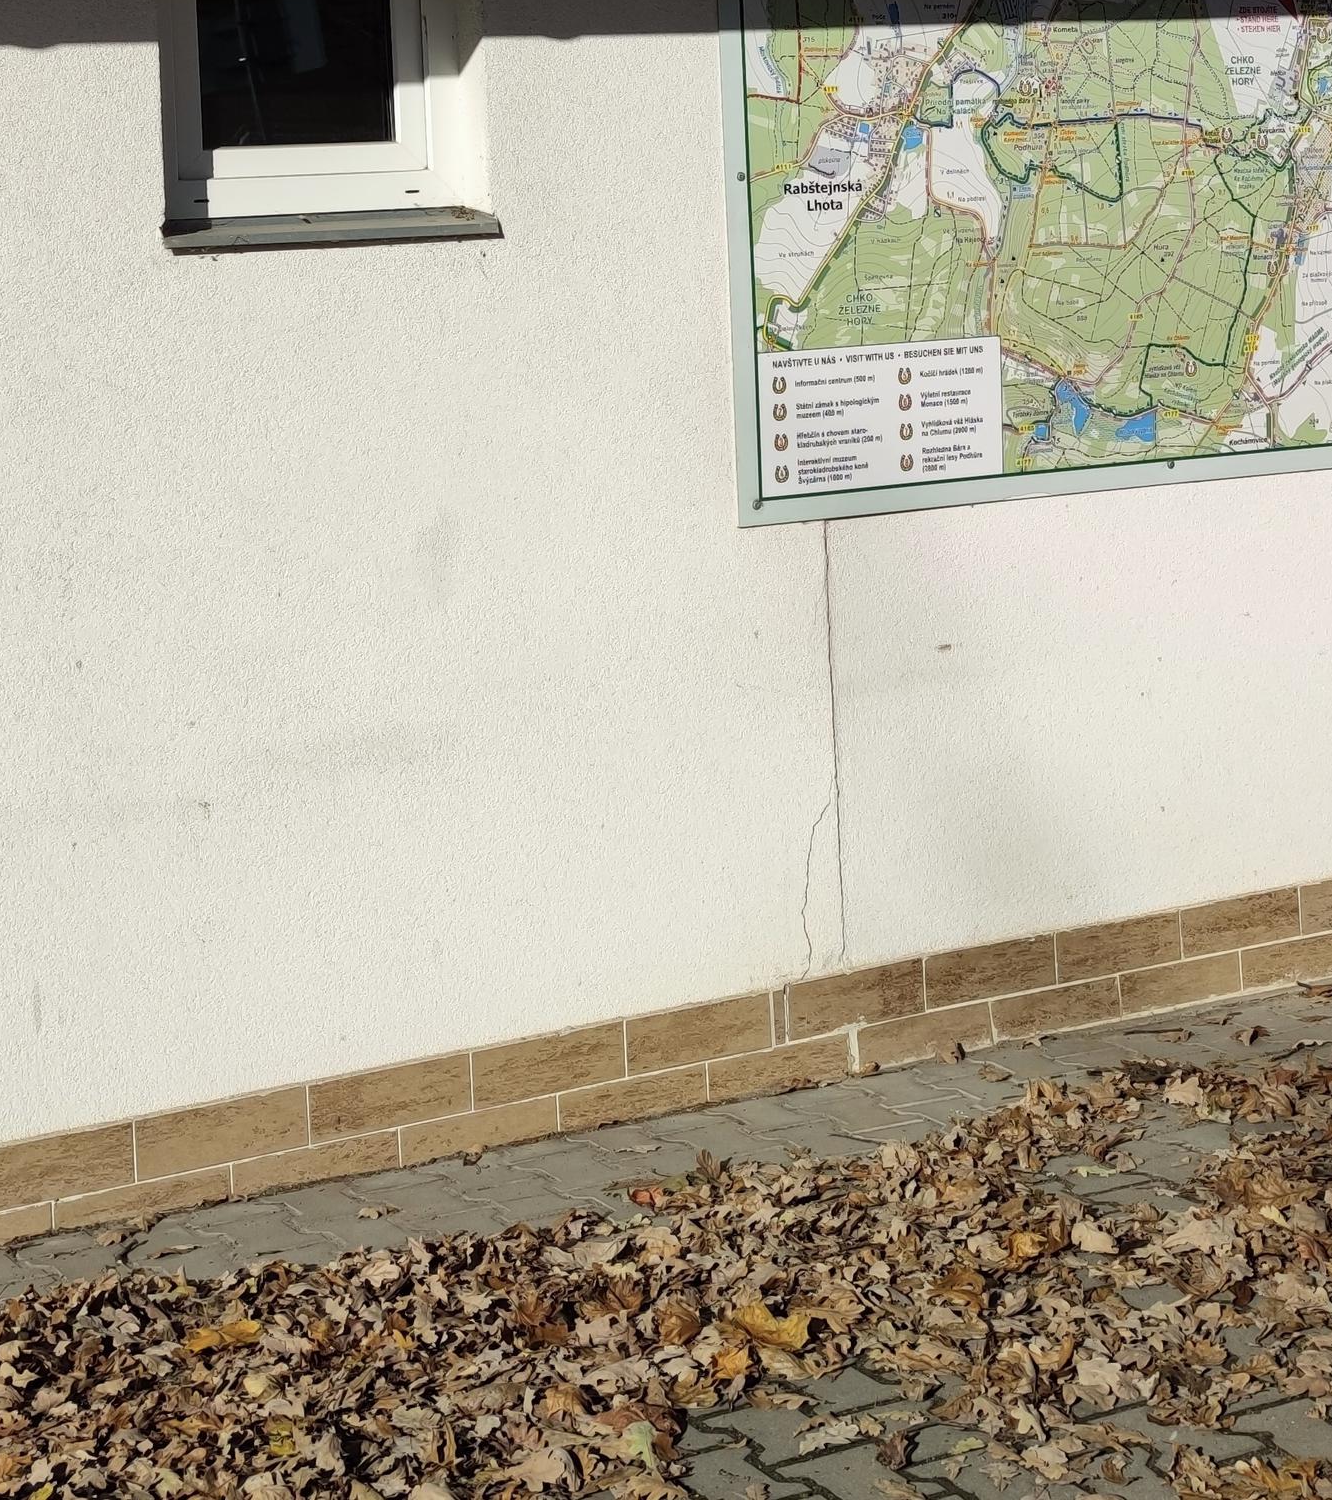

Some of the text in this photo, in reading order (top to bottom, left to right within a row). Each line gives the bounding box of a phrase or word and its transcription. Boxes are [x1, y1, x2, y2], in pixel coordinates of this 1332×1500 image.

[1231, 56, 1254, 64] CHKO
[1225, 65, 1262, 75] ŽELEZNÉ
[1231, 78, 1254, 86] HORY
[783, 179, 863, 196] Rabštejnská
[807, 200, 843, 212] Lhota
[845, 293, 873, 303] CHKO
[839, 304, 881, 316] ŽELEZNÉ
[846, 317, 873, 326] HORY
[821, 355, 836, 365] NÁS
[845, 354, 863, 363] VISIT
[863, 353, 883, 361] WITH
[885, 352, 894, 360] US
[904, 349, 941, 359] BESUCHEN
[943, 347, 955, 356] SIE
[956, 347, 967, 355] MIT
[969, 345, 983, 354] UNS
